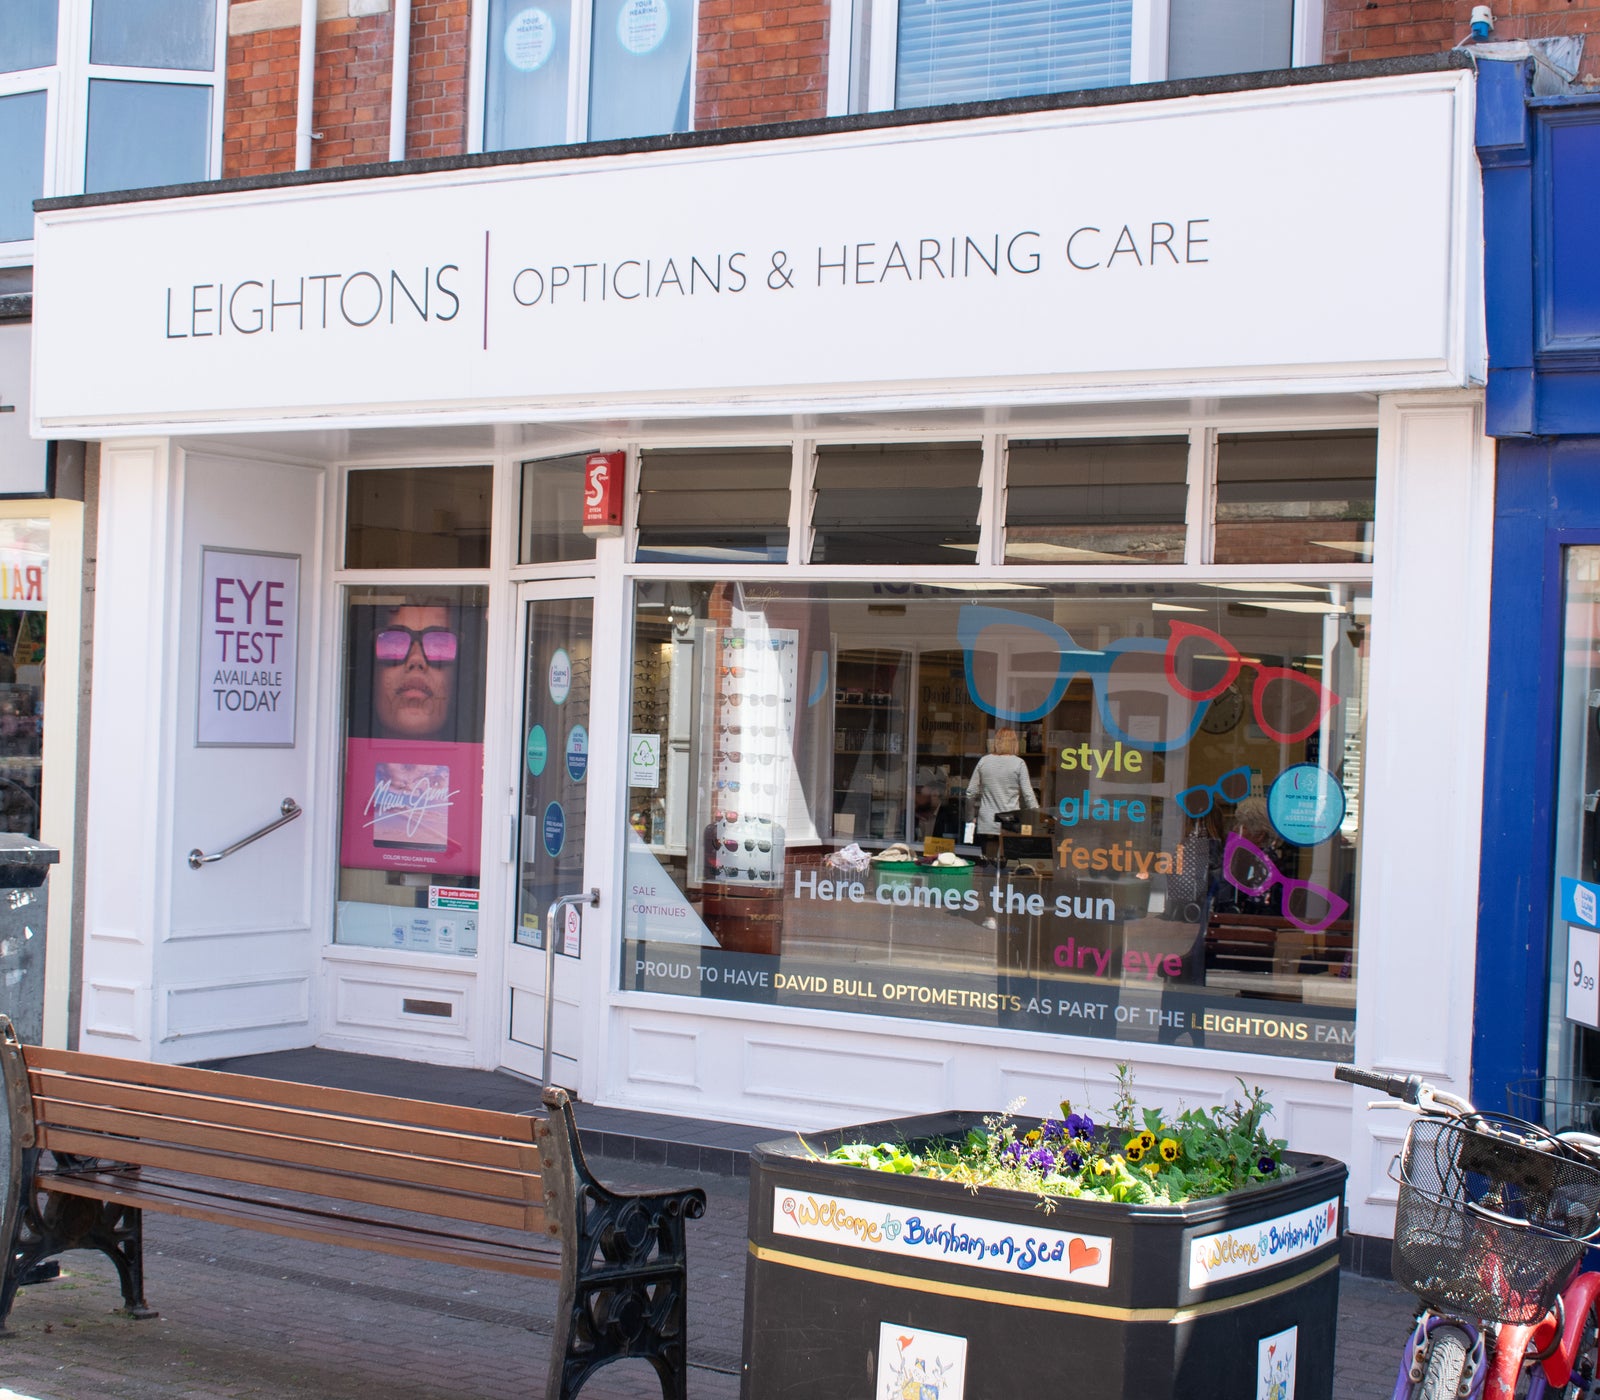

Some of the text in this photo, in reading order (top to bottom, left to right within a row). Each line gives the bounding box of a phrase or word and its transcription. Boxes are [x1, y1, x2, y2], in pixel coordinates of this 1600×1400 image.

[166, 218, 1210, 339] LEIGHTONS OPTICIANS & HEARING CARE
[215, 577, 285, 627] EYE
[215, 630, 284, 664] TEST
[213, 669, 282, 687] AVAILABLE
[213, 689, 282, 712] TODAY
[1060, 741, 1143, 779] style
[364, 776, 460, 838] Maui Jim
[1059, 789, 1147, 827] glare
[1057, 838, 1184, 876] festival
[632, 885, 656, 897] SALE
[793, 869, 1116, 921] Here comes the sun
[632, 904, 686, 918] CONTINUES
[1053, 937, 1183, 981] dry eye
[1573, 960, 1595, 991] 9.99
[635, 960, 692, 980] PROUD
[697, 966, 719, 982] TO
[724, 969, 769, 988] HAVE
[774, 973, 828, 994] DAVID
[833, 979, 878, 999] BULL
[882, 983, 1022, 1011] OPTOMETRISTS
[1026, 997, 1053, 1015] AS
[1058, 1000, 1109, 1020] PART
[1114, 1005, 1140, 1023] OF
[1146, 1008, 1185, 1029] THE
[1191, 1013, 1309, 1041] LEIGHTONS
[798, 1195, 1066, 1271] Welcome to Burnham-on-Sea
[1208, 1234, 1259, 1270] Welcome
[1258, 1229, 1269, 1257] to
